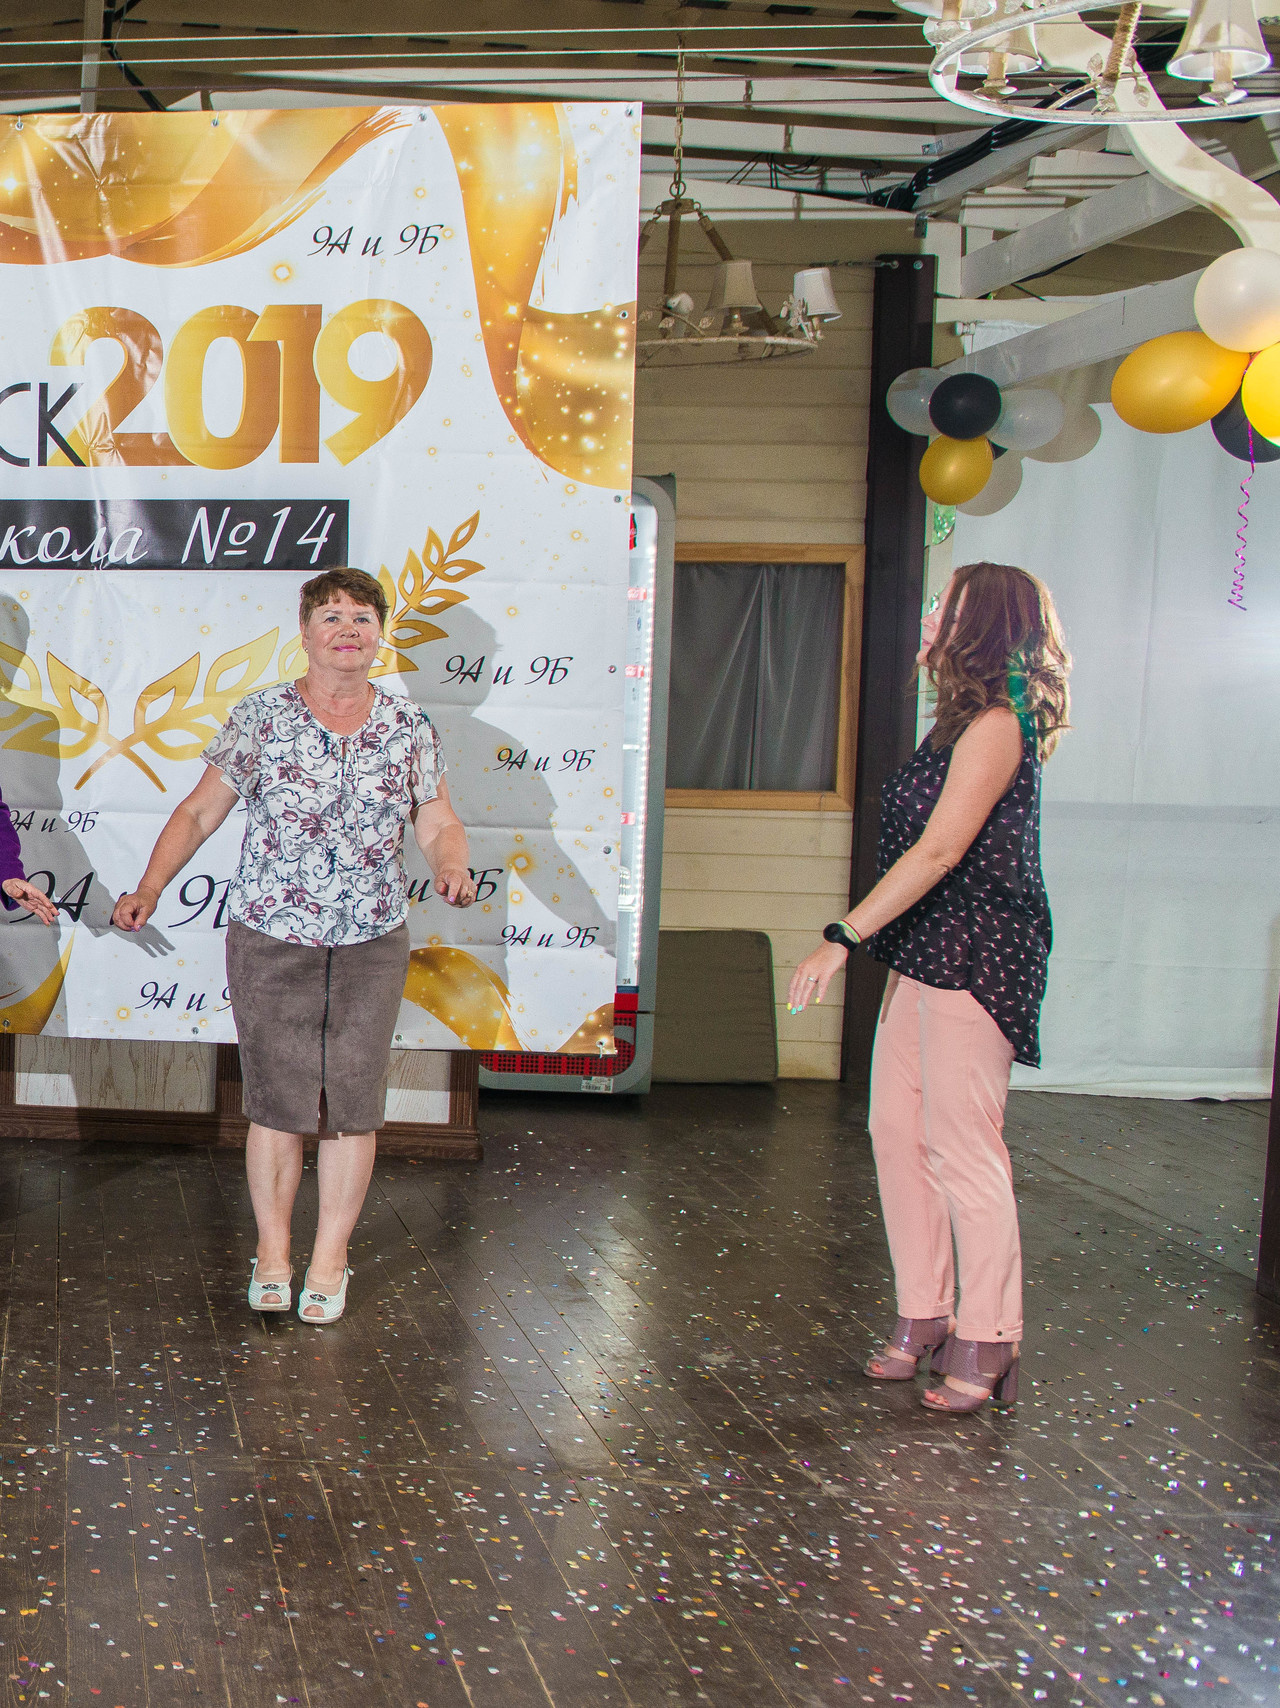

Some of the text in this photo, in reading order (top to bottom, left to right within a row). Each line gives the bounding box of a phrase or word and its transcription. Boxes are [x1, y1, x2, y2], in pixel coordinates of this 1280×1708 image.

[306, 224, 445, 257] 9А и 9Б
[47, 298, 433, 470] 2019
[439, 655, 574, 686] 9А и 9Б
[492, 748, 596, 772] 9А и 9Б
[41, 818, 58, 833] и
[64, 811, 99, 833] 9Б
[467, 867, 504, 902] Б
[496, 925, 600, 948] 9А и 9Б
[135, 981, 179, 1010] 9А
[186, 993, 207, 1011] и
